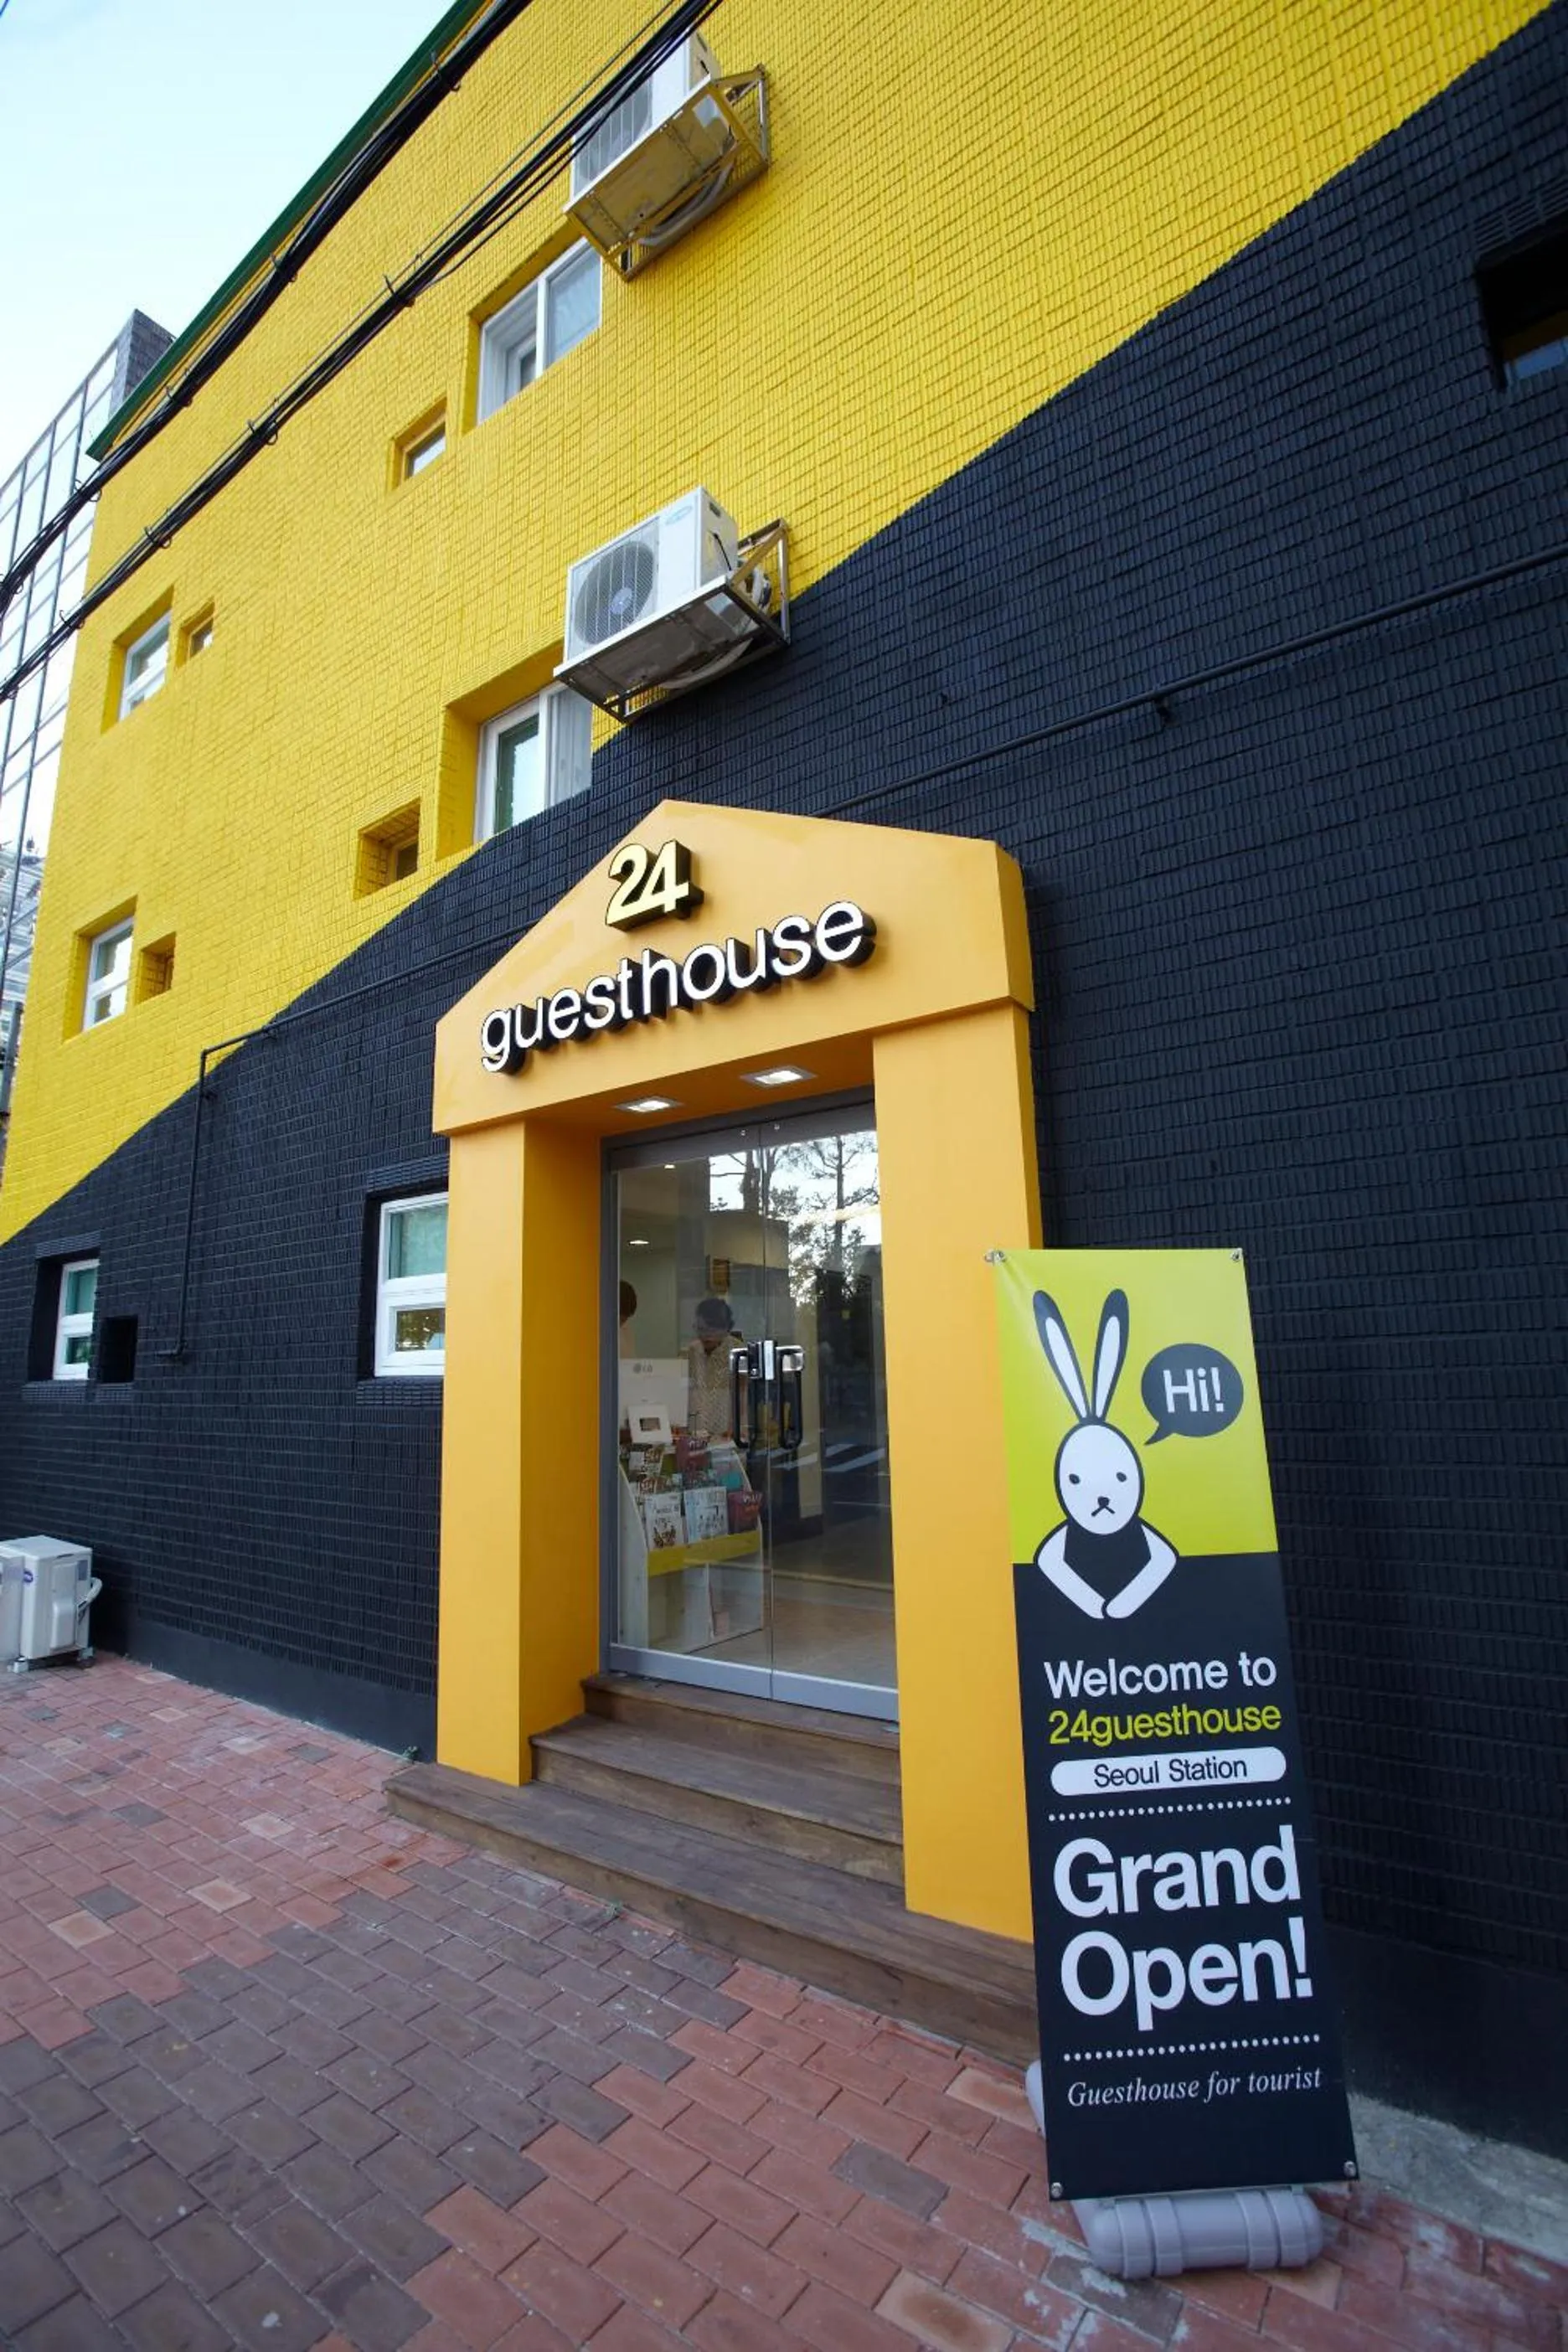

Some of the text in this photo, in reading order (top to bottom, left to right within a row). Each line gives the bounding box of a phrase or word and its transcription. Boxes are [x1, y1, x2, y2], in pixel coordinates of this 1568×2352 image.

[605, 839, 694, 927] 24
[480, 900, 866, 1074] guesthouse
[1162, 1366, 1225, 1414] Hi!
[1044, 1651, 1277, 1699] Welcome to
[1048, 1703, 1282, 1747] 24guesthouse
[1093, 1756, 1248, 1788] Seoul Station
[1052, 1824, 1302, 1918] Grand
[1060, 1916, 1313, 2032] Open!
[1067, 2066, 1323, 2107] Guesthouse for tourist
